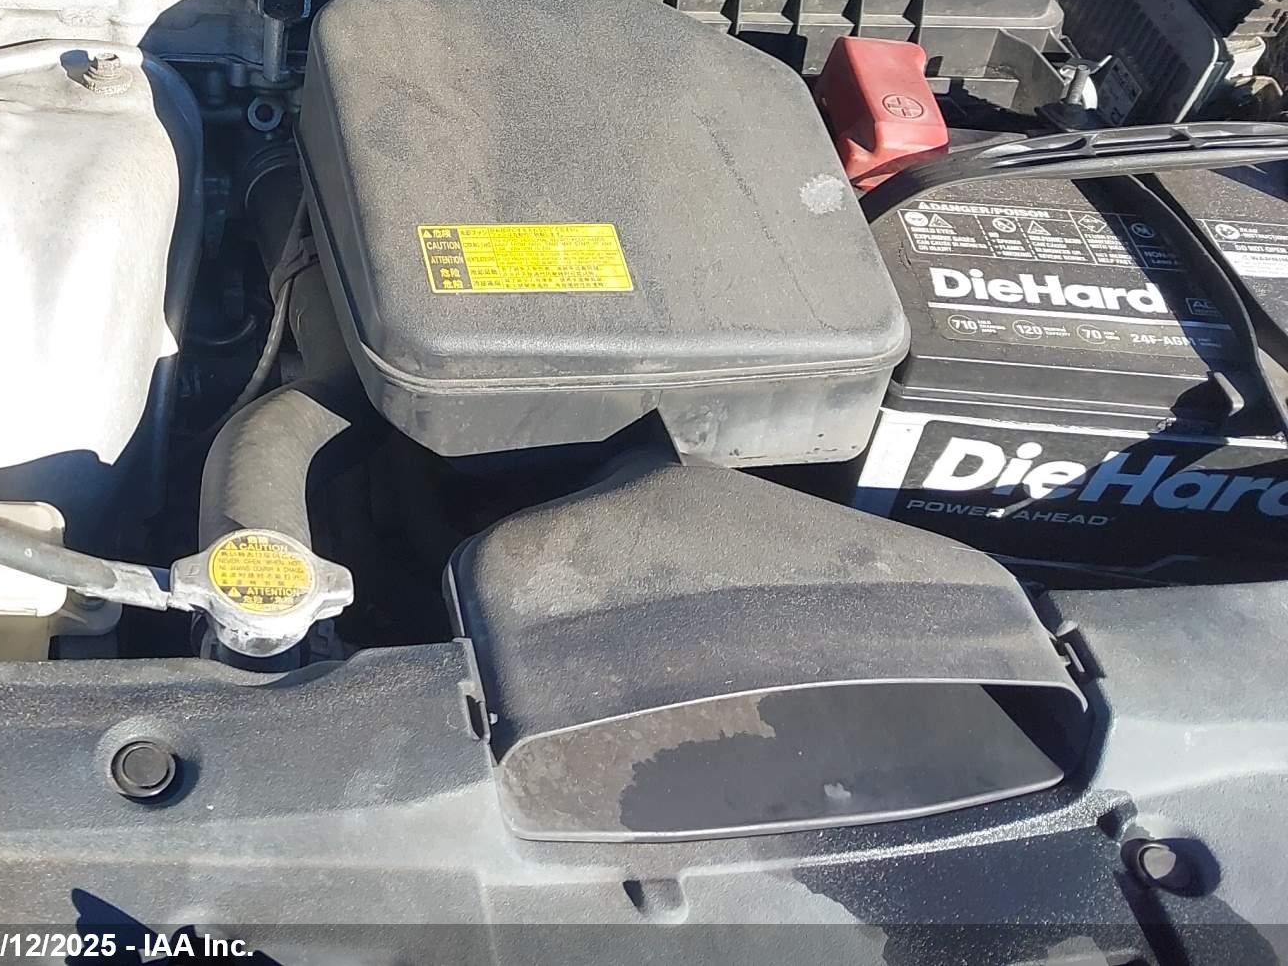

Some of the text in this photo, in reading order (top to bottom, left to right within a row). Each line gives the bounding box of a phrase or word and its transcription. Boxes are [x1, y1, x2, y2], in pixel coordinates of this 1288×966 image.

[928, 202, 1050, 219] DANGER/POISON
[426, 241, 461, 251] CAUTION
[430, 255, 464, 264] ATTENTION
[929, 266, 1170, 314] DieHard
[951, 319, 978, 330] 710
[1016, 324, 1043, 336] 120
[1081, 328, 1102, 340] 70
[906, 499, 1109, 526] POWER AHEAD
[239, 544, 289, 553] CAUTION
[246, 587, 301, 597] ATTENTION
